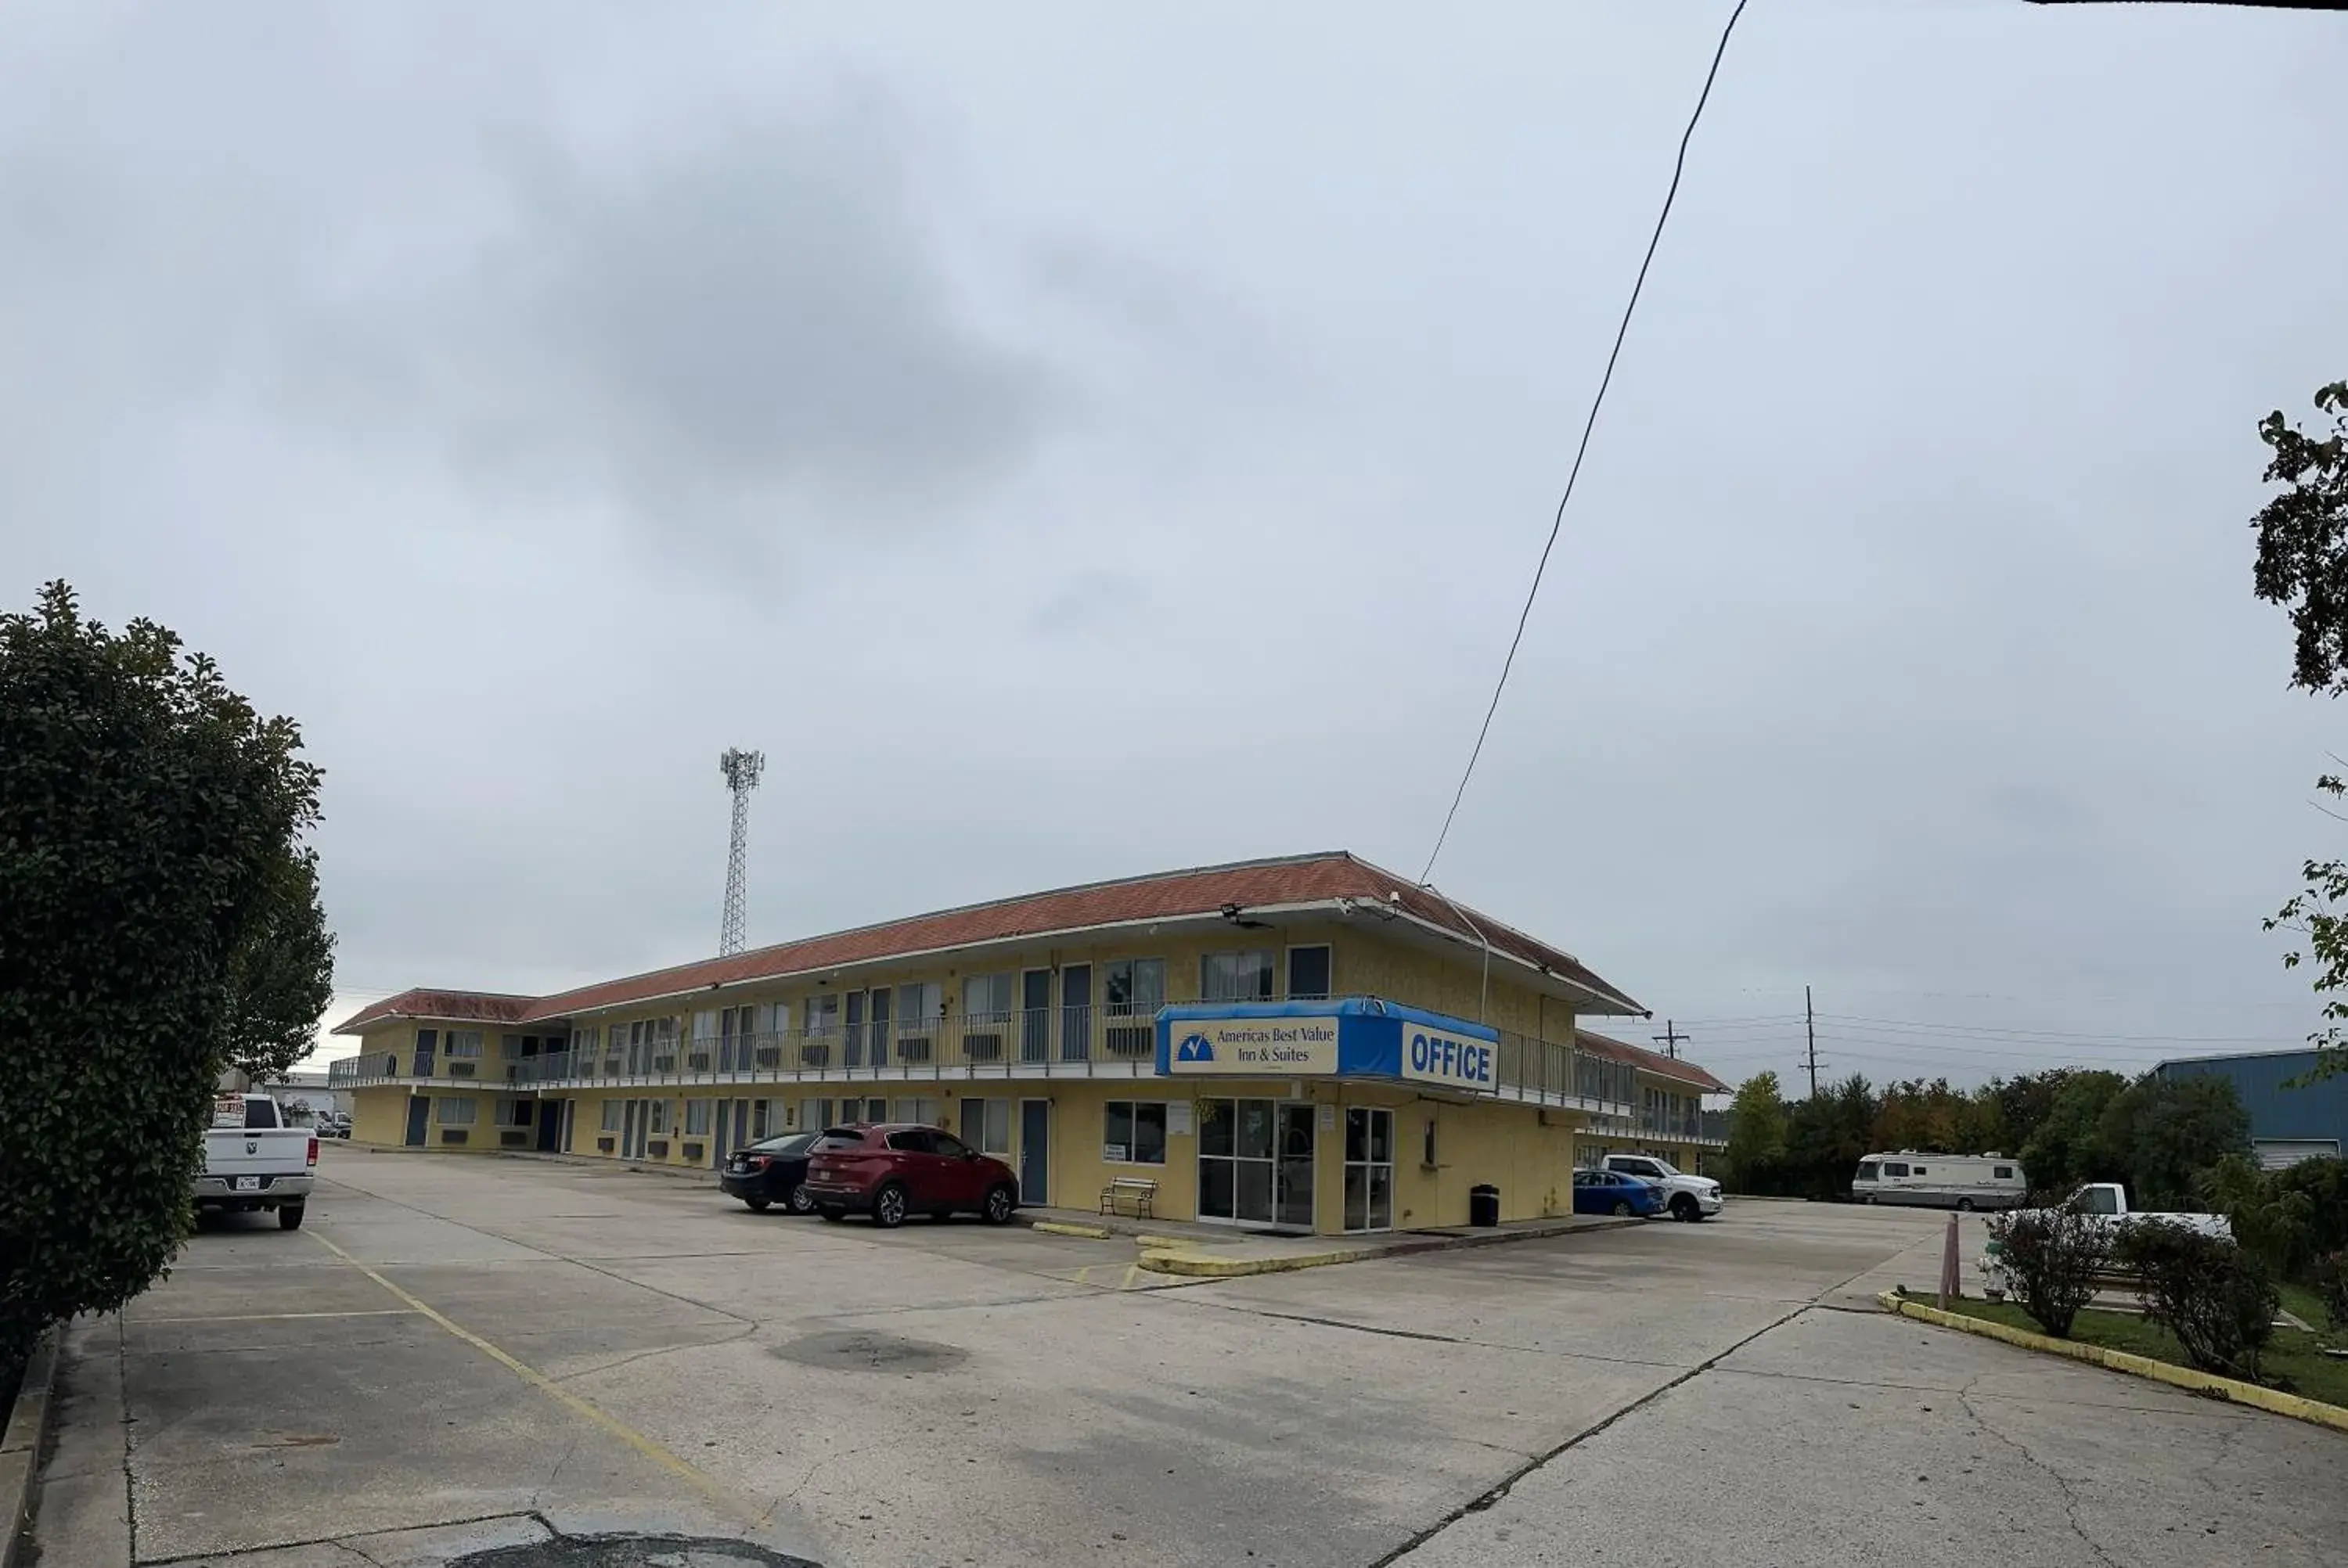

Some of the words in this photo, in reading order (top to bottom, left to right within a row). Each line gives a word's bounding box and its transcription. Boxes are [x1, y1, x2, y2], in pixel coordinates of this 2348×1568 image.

[1217, 1029, 1270, 1043] Americas
[1273, 1028, 1297, 1042] Best
[1301, 1026, 1334, 1042] Value
[1239, 1048, 1256, 1062] Inn
[1259, 1048, 1269, 1062] &
[1273, 1047, 1309, 1062] Suites
[1411, 1034, 1491, 1081] OFFICE
